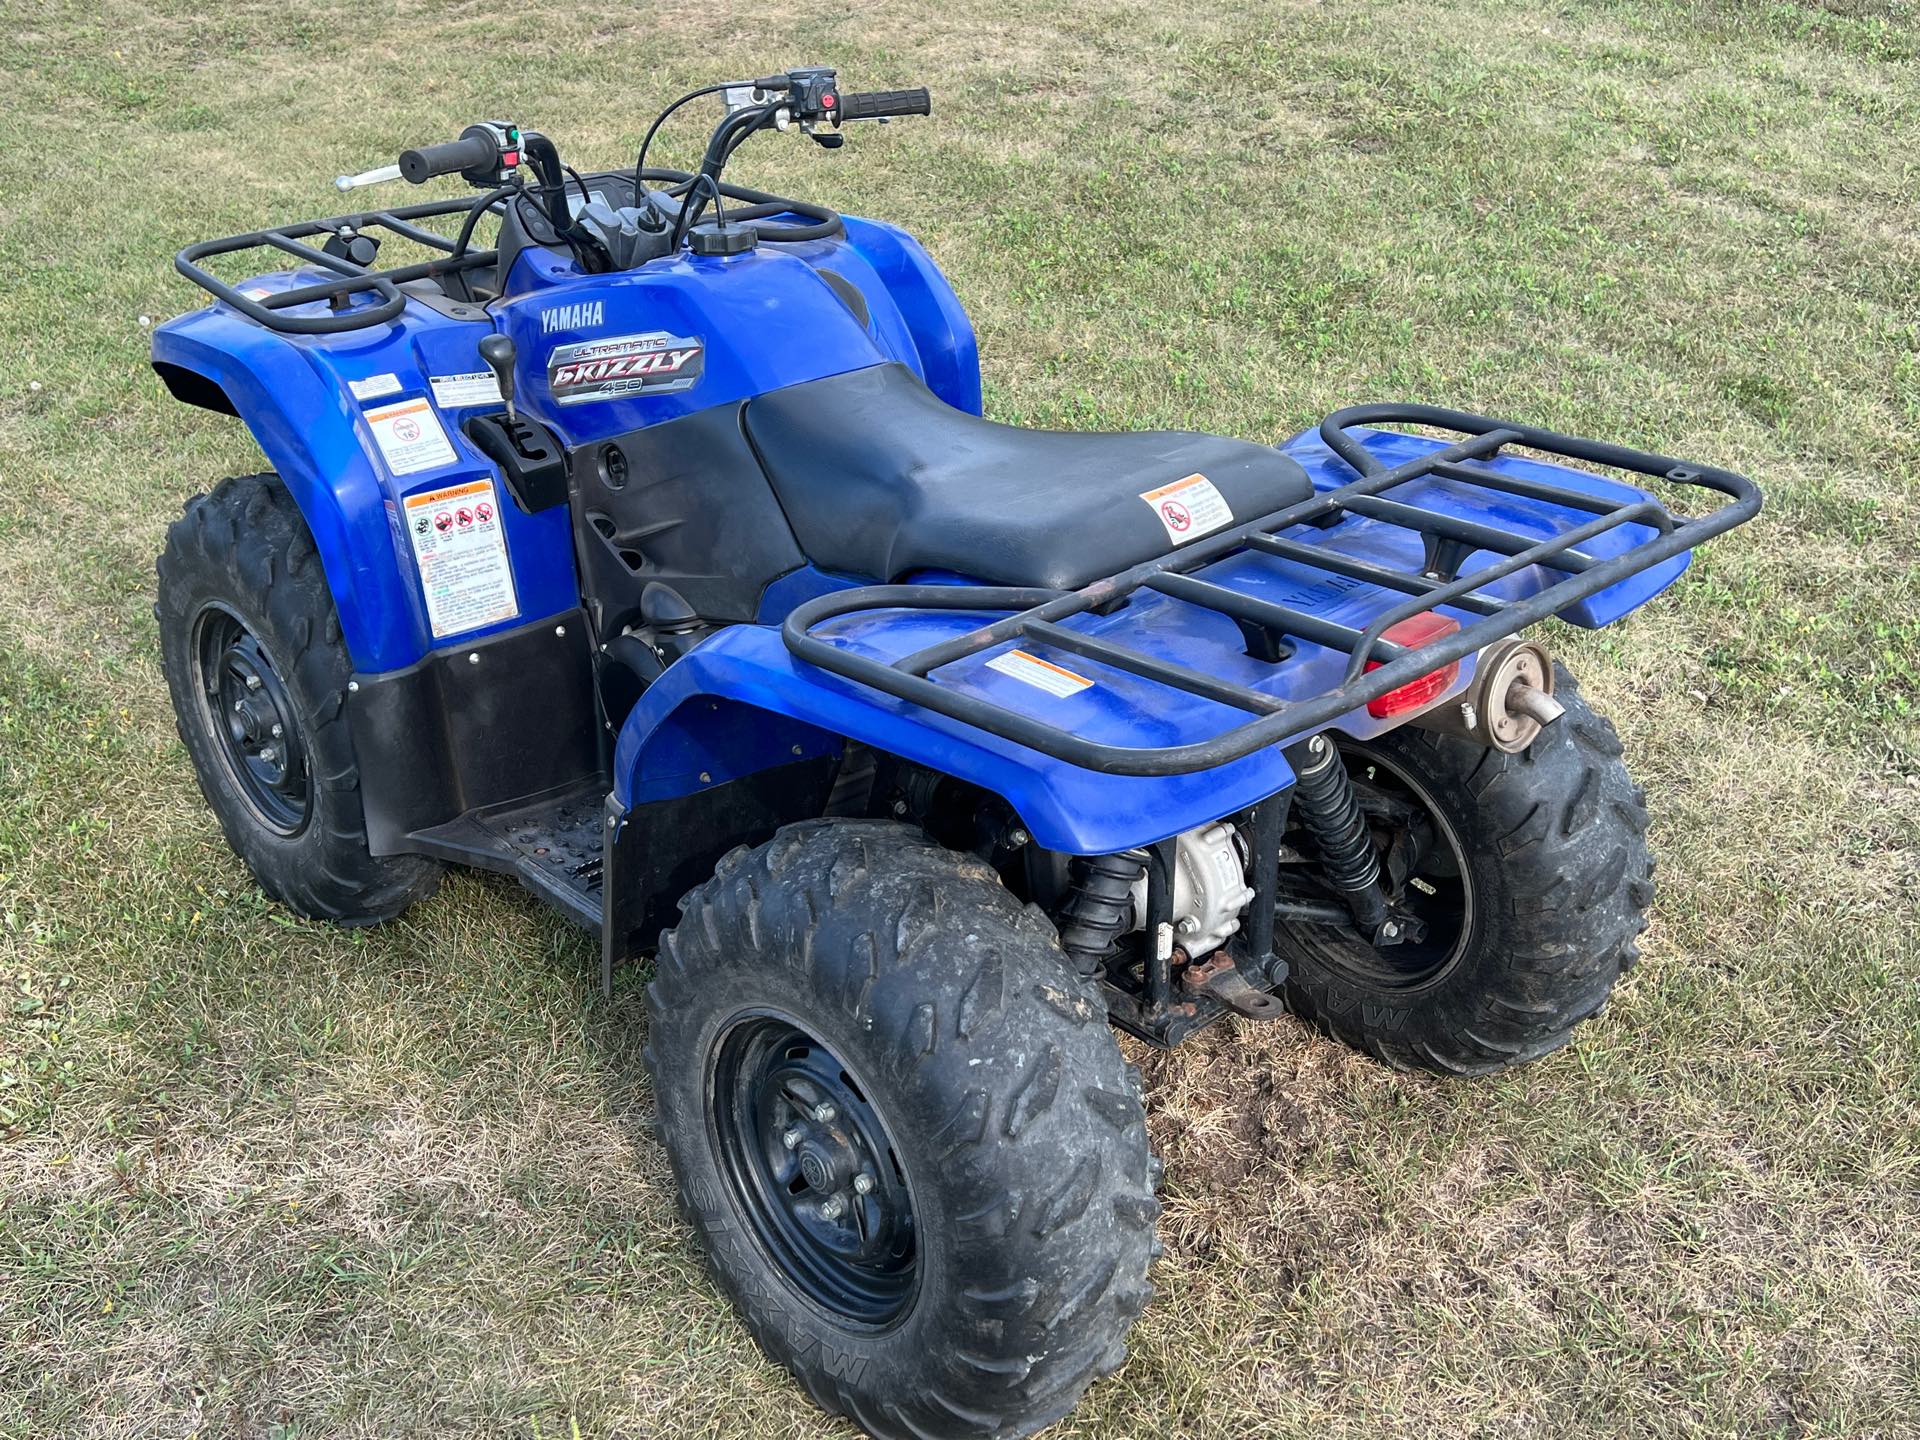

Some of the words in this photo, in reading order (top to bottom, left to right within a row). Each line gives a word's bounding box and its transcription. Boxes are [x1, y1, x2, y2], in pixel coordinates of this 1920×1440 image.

[541, 301, 603, 333] YAMAHA
[573, 338, 668, 358] ULTRAMATIC
[553, 348, 701, 387] GRIZZLY
[600, 378, 642, 395] 450
[436, 486, 469, 500] WARNING
[688, 1175, 871, 1386] MAXXIS
